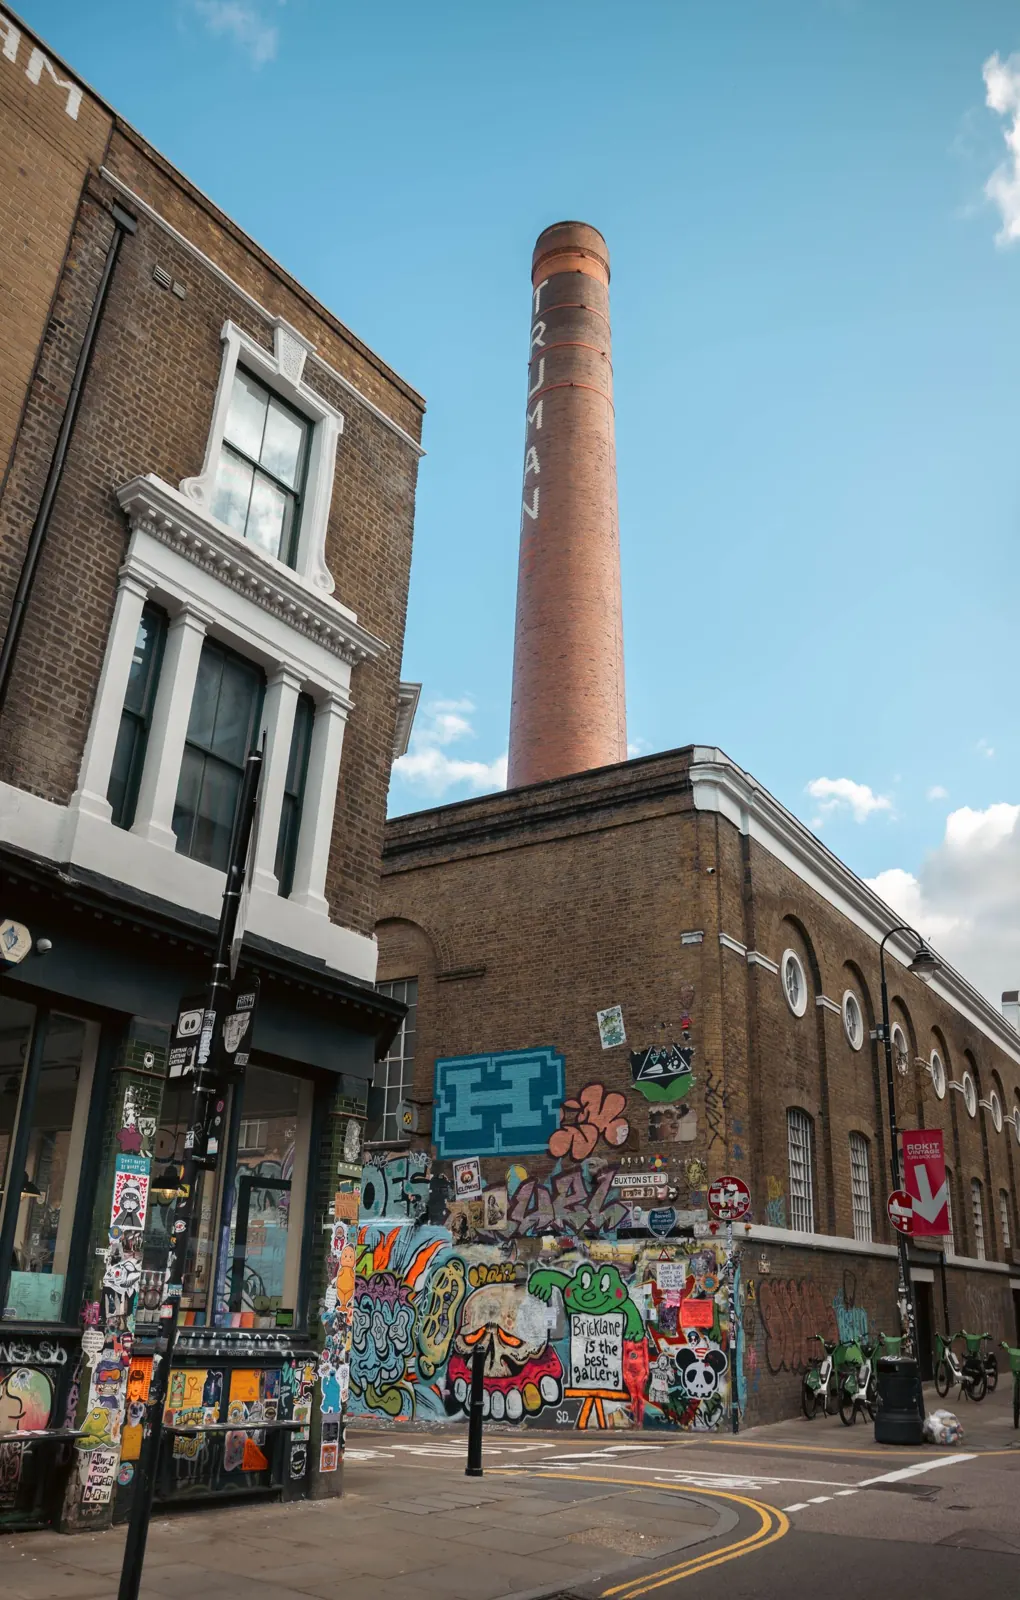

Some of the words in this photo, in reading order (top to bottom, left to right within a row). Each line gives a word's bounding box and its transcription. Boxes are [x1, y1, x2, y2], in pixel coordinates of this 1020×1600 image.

[520, 279, 548, 531] TRUMAN
[456, 1164, 471, 1172] VOTE
[614, 1176, 641, 1185] BUXTON
[458, 1184, 479, 1192] CLOWNS
[585, 1340, 595, 1354] is
[599, 1339, 618, 1356] the
[584, 1354, 608, 1368] best
[573, 1366, 620, 1387] gallery
[88, 1475, 113, 1486] NEVER
